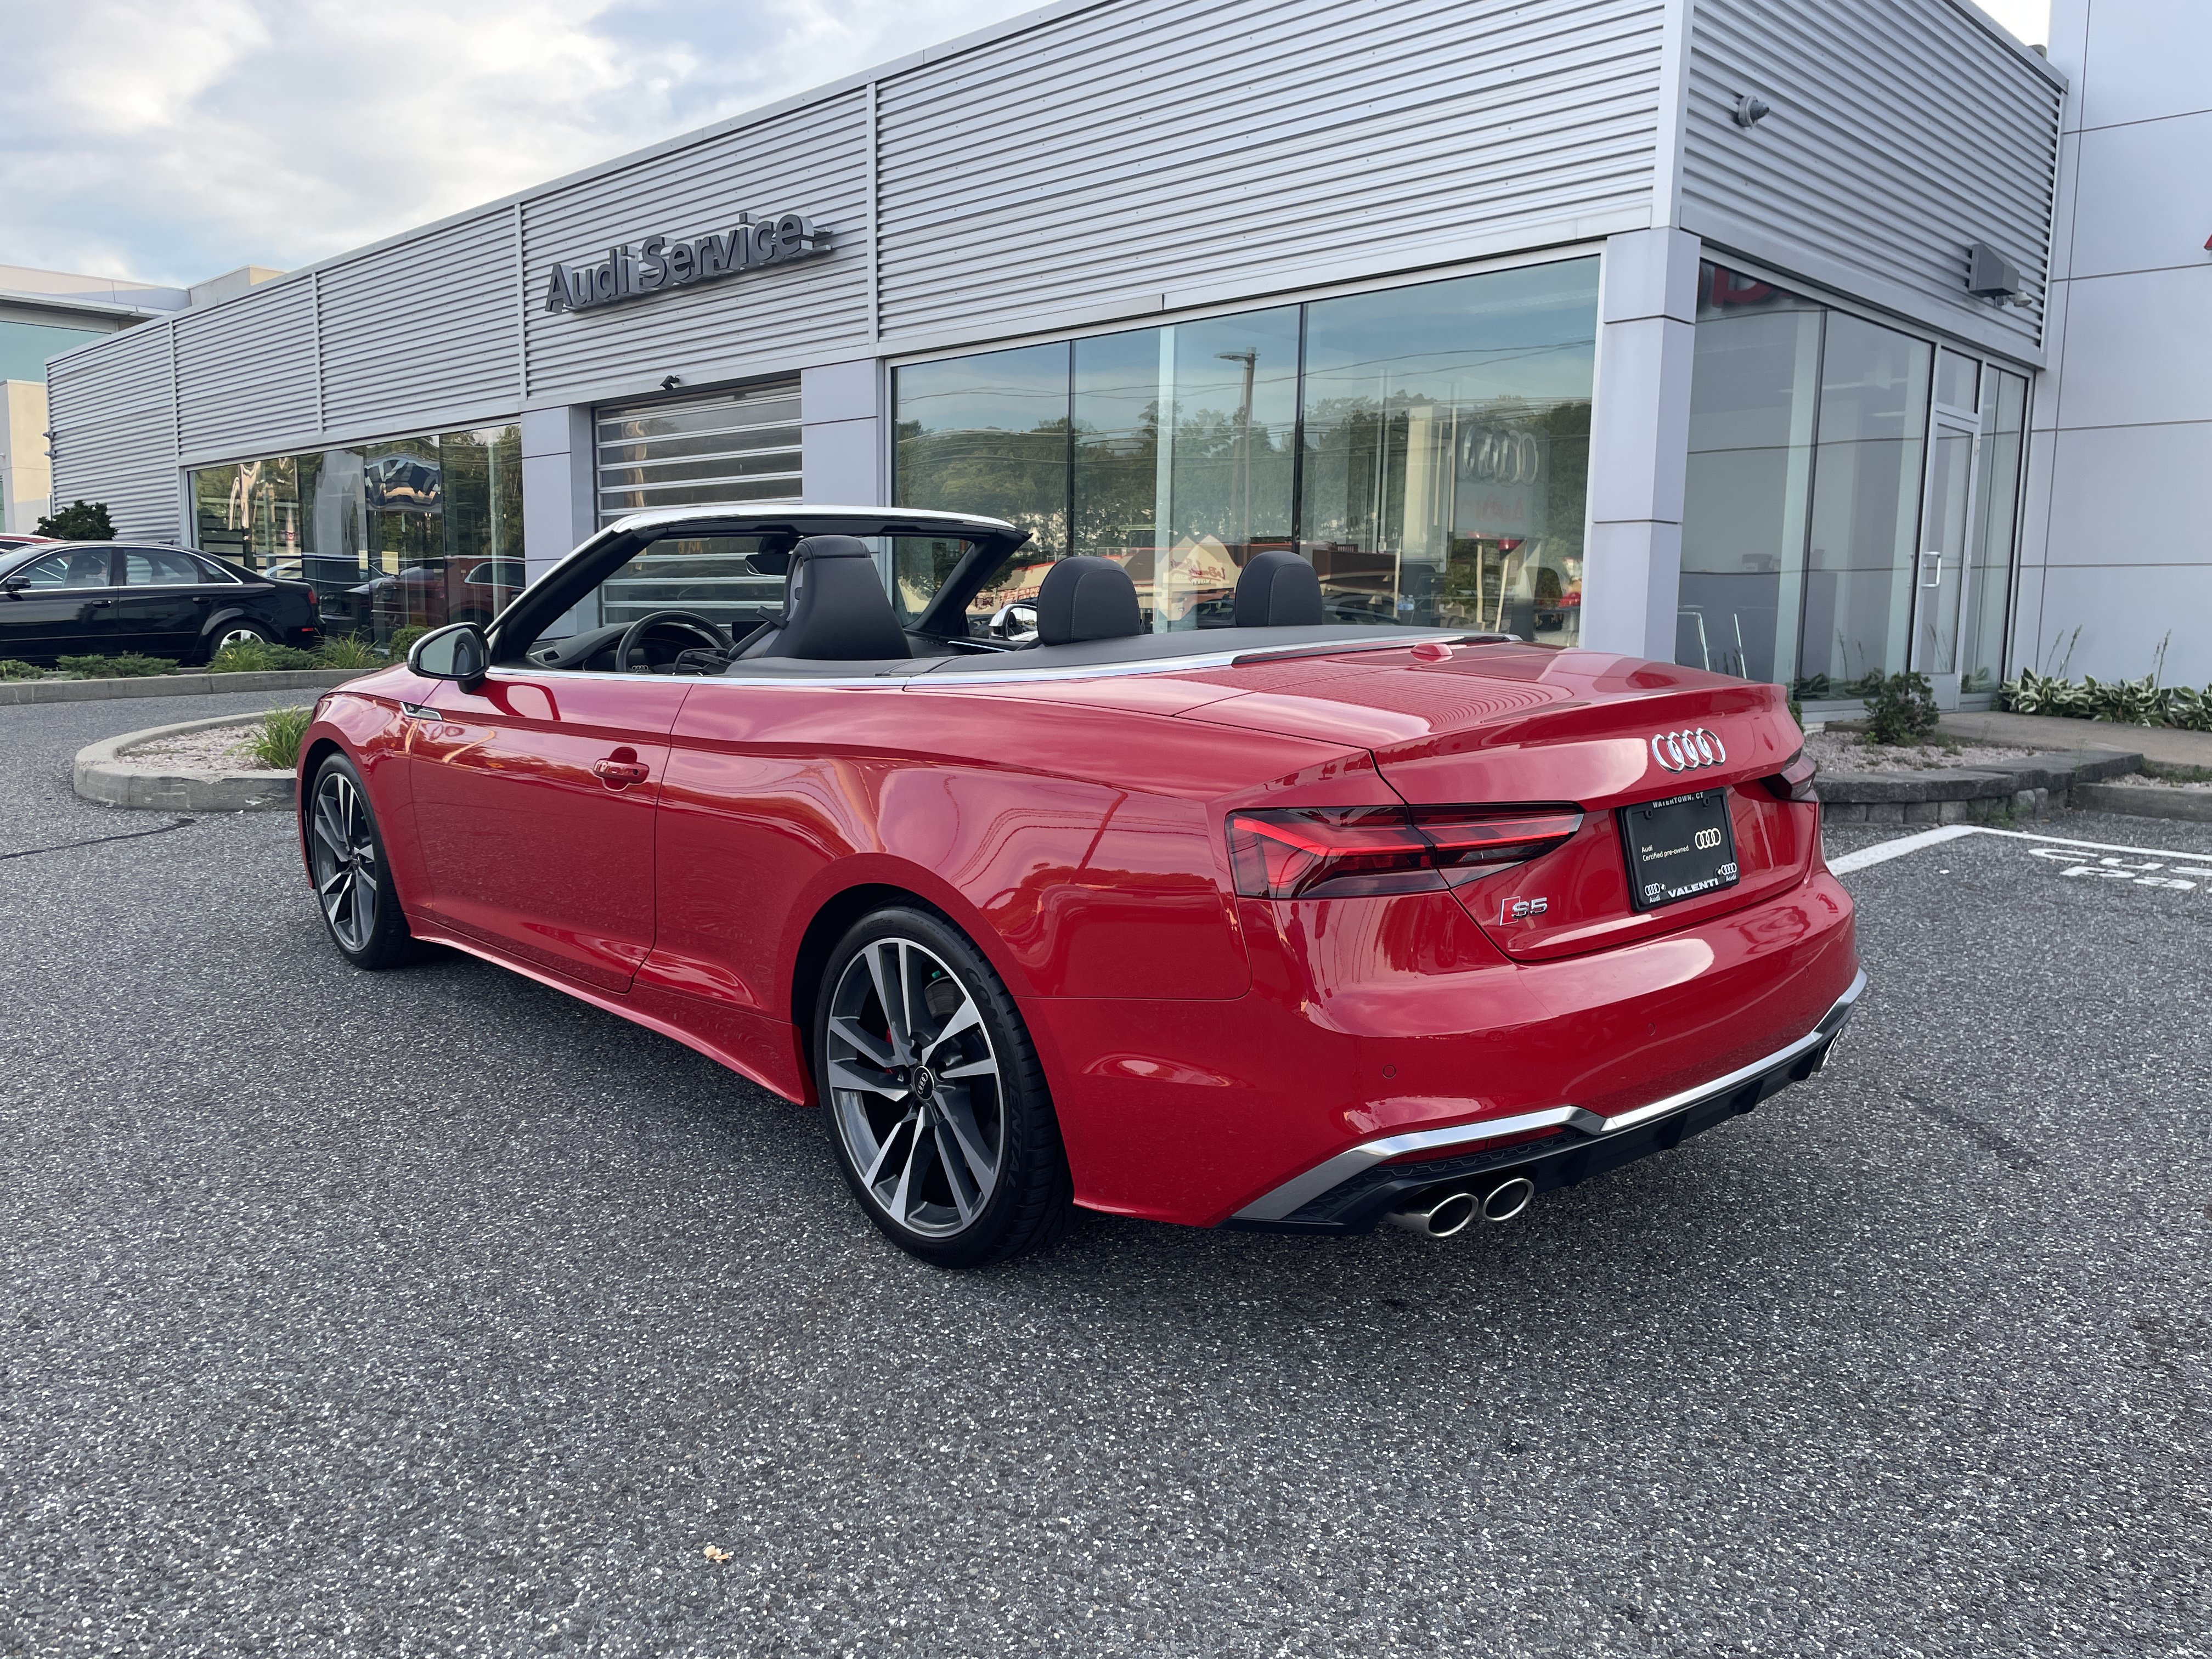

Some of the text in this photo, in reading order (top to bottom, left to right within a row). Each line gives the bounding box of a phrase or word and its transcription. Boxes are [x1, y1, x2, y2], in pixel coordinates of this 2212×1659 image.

[545, 212, 815, 313] Audi Service
[1641, 844, 1653, 853] Audi
[1643, 845, 1689, 862] Certified pre-owned
[1726, 873, 1737, 882] Audi
[1667, 878, 1719, 898] VALENTI
[1511, 896, 1549, 919] S5
[1649, 894, 1661, 904] Audi
[964, 967, 1023, 1189] CONNENTAL
